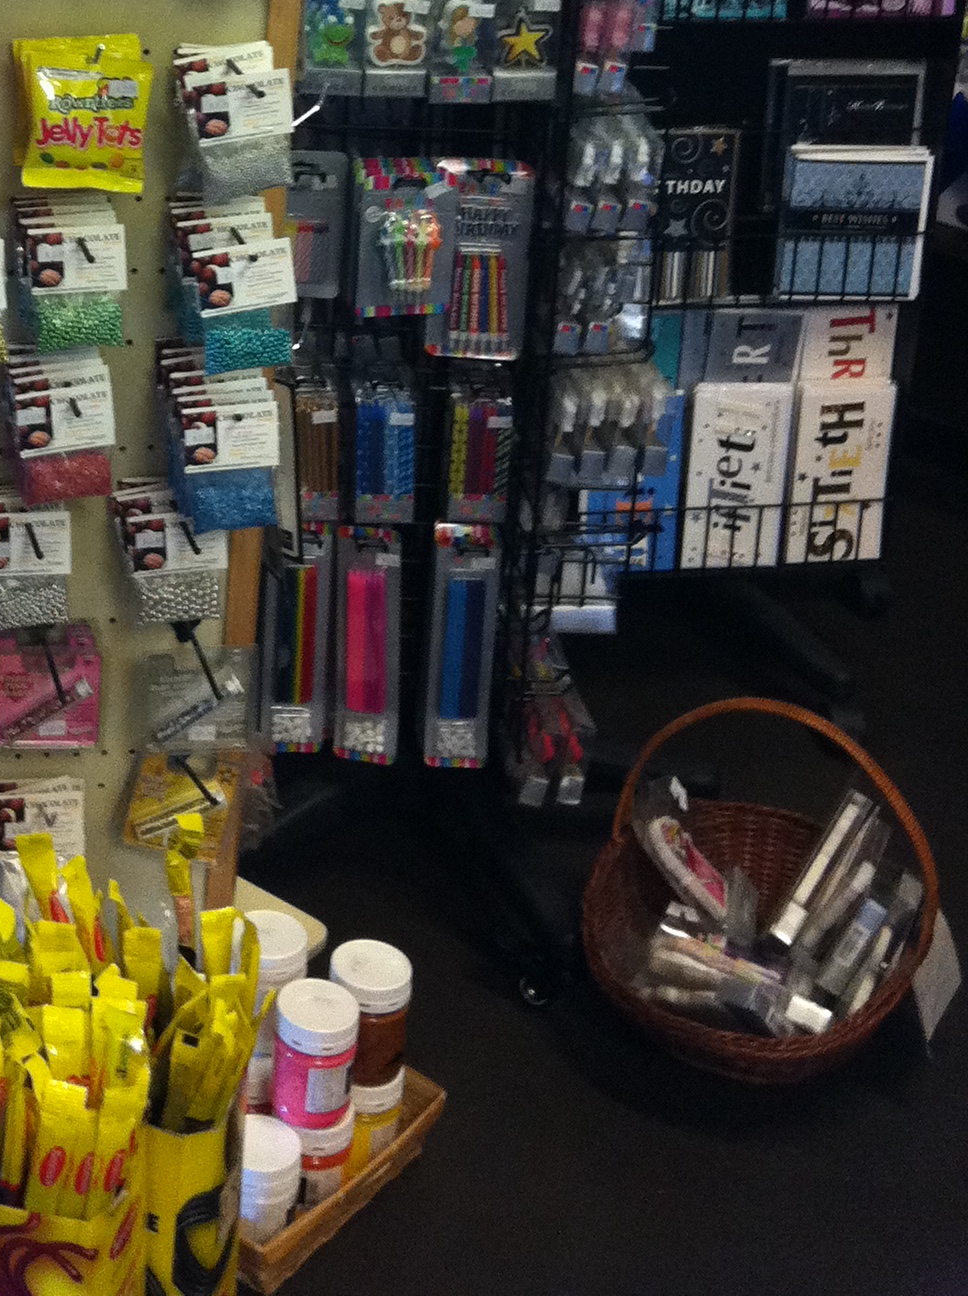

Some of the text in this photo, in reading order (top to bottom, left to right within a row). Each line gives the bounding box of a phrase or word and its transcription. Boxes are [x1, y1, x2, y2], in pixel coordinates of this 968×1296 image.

[35, 116, 144, 151] Jelly Tots
[654, 179, 727, 195] THDAY
